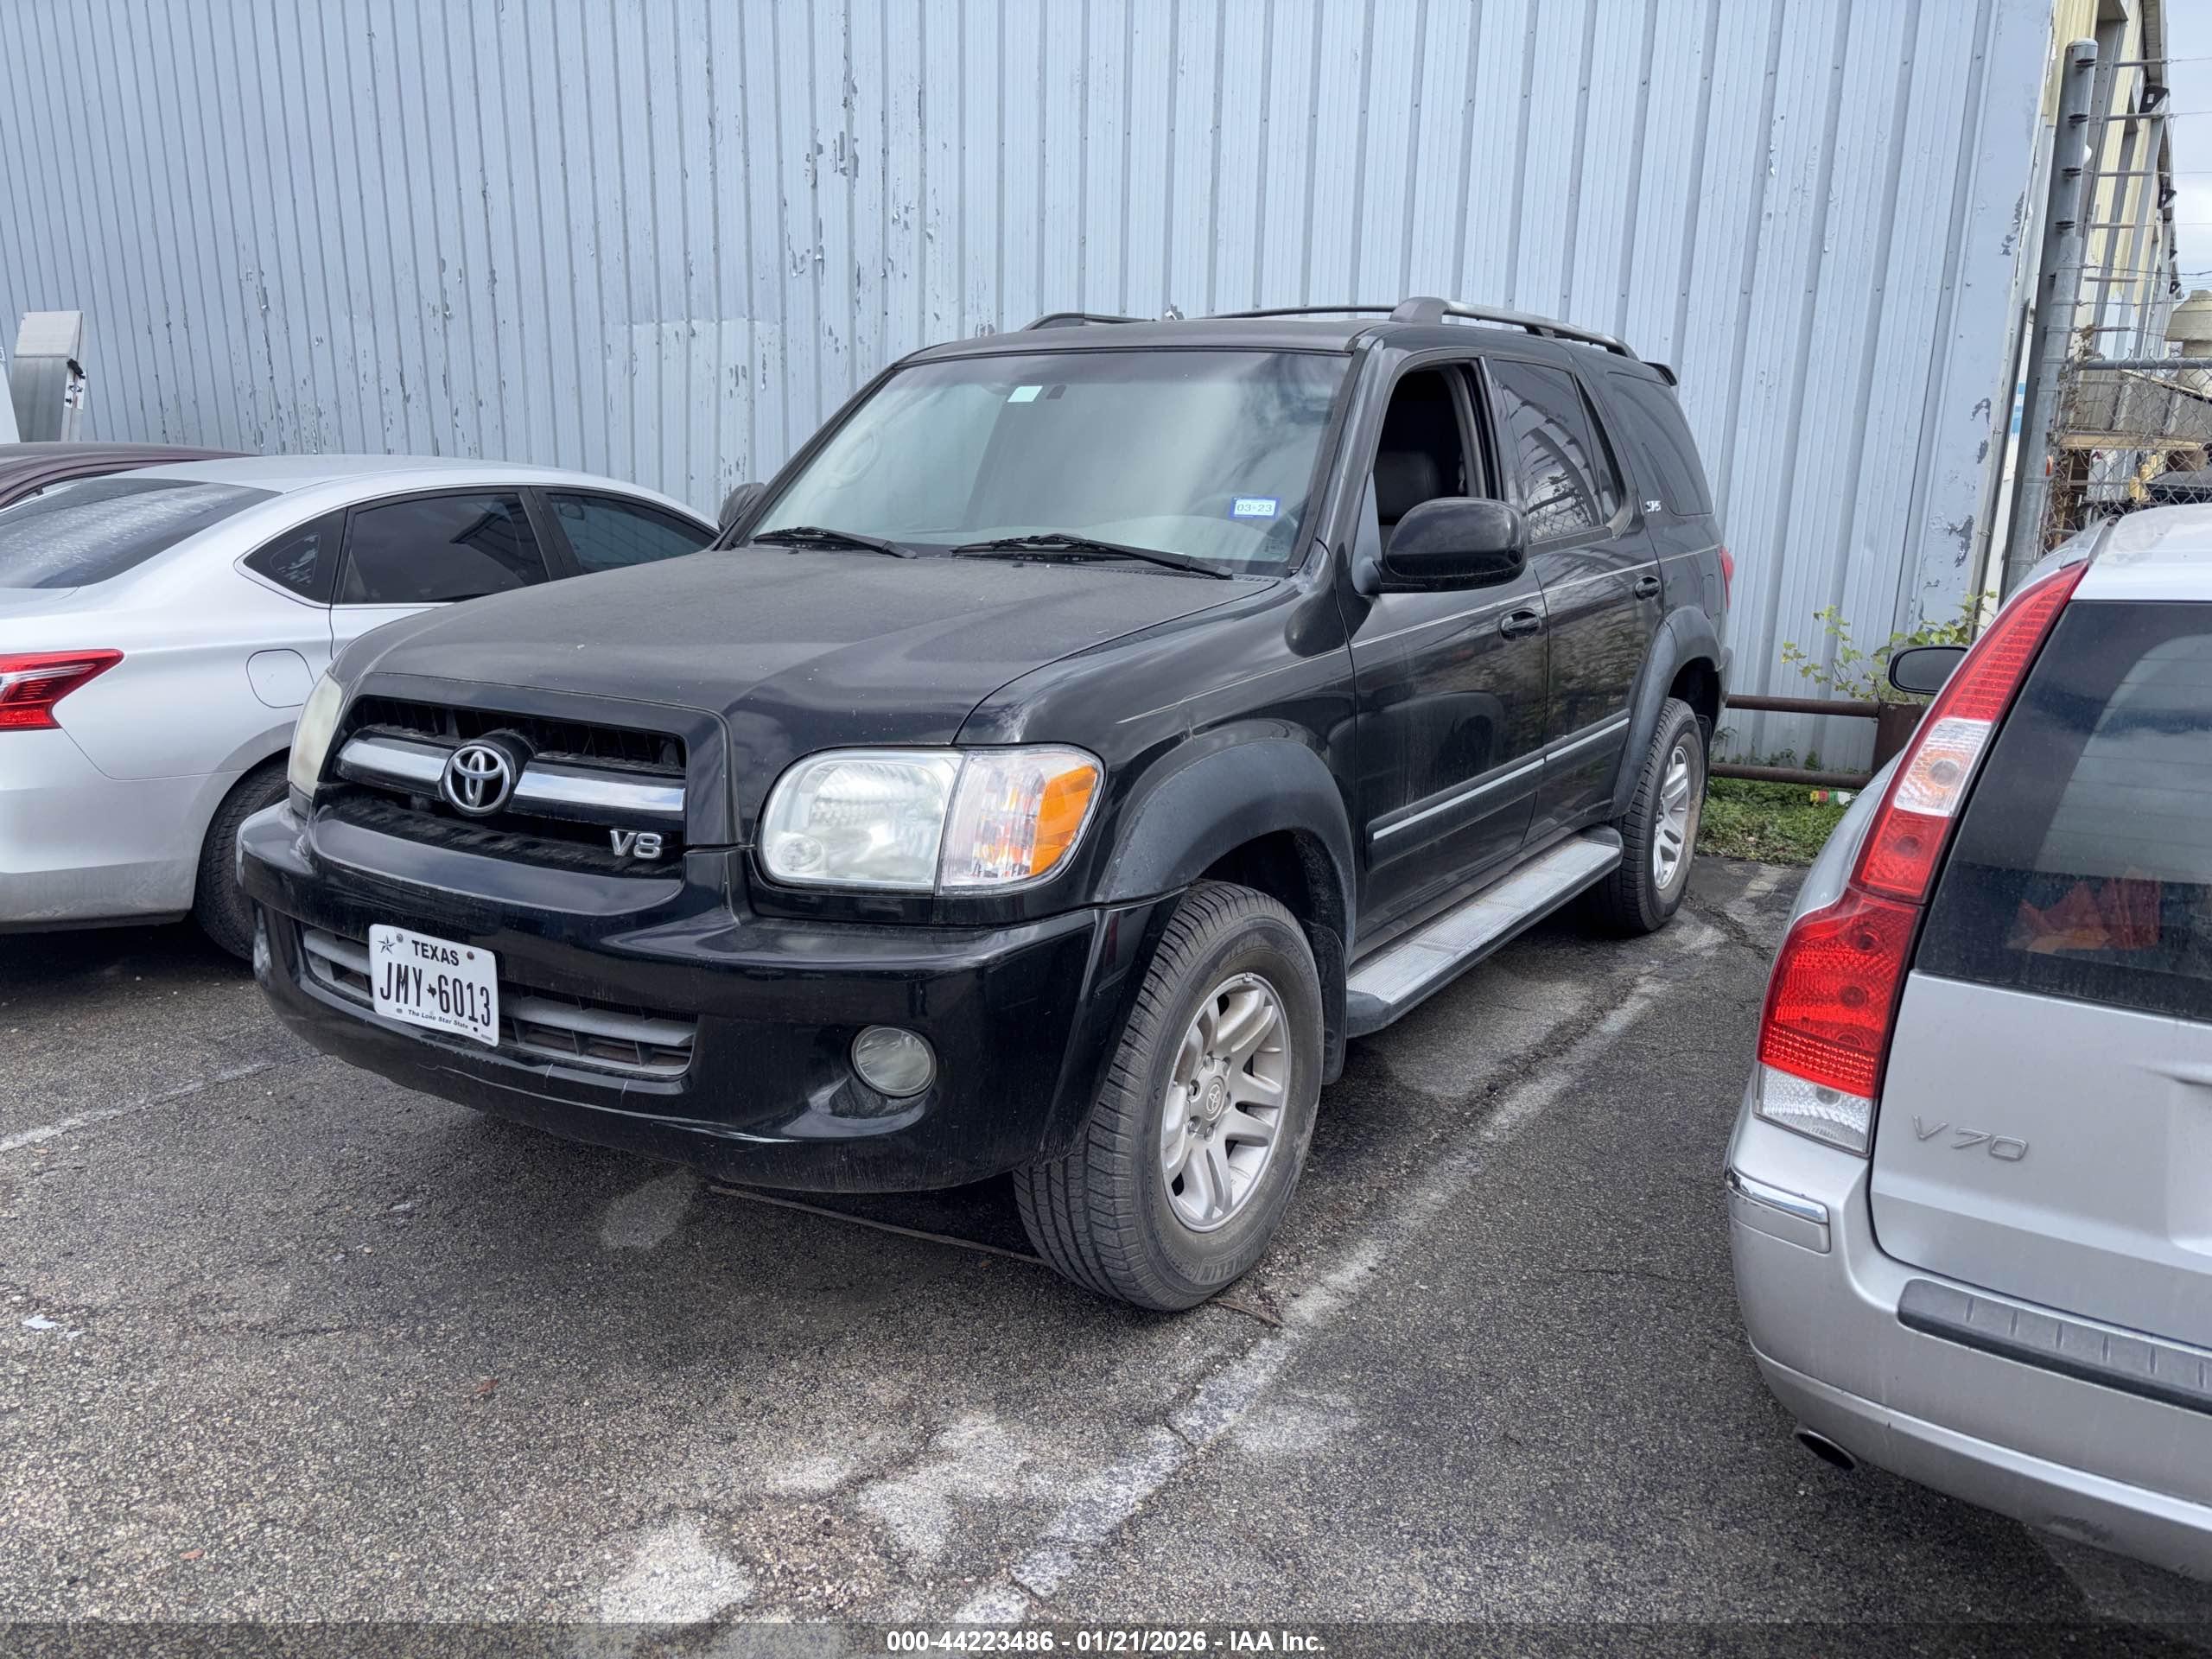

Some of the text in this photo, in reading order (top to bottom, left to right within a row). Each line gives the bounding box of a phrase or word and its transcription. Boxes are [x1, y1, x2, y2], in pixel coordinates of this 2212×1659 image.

[609, 830, 662, 859] V8
[411, 939, 460, 966] TEXAS
[380, 962, 491, 1027] JMY 6013
[454, 1020, 468, 1028] State
[1912, 1113, 2029, 1161] V70
